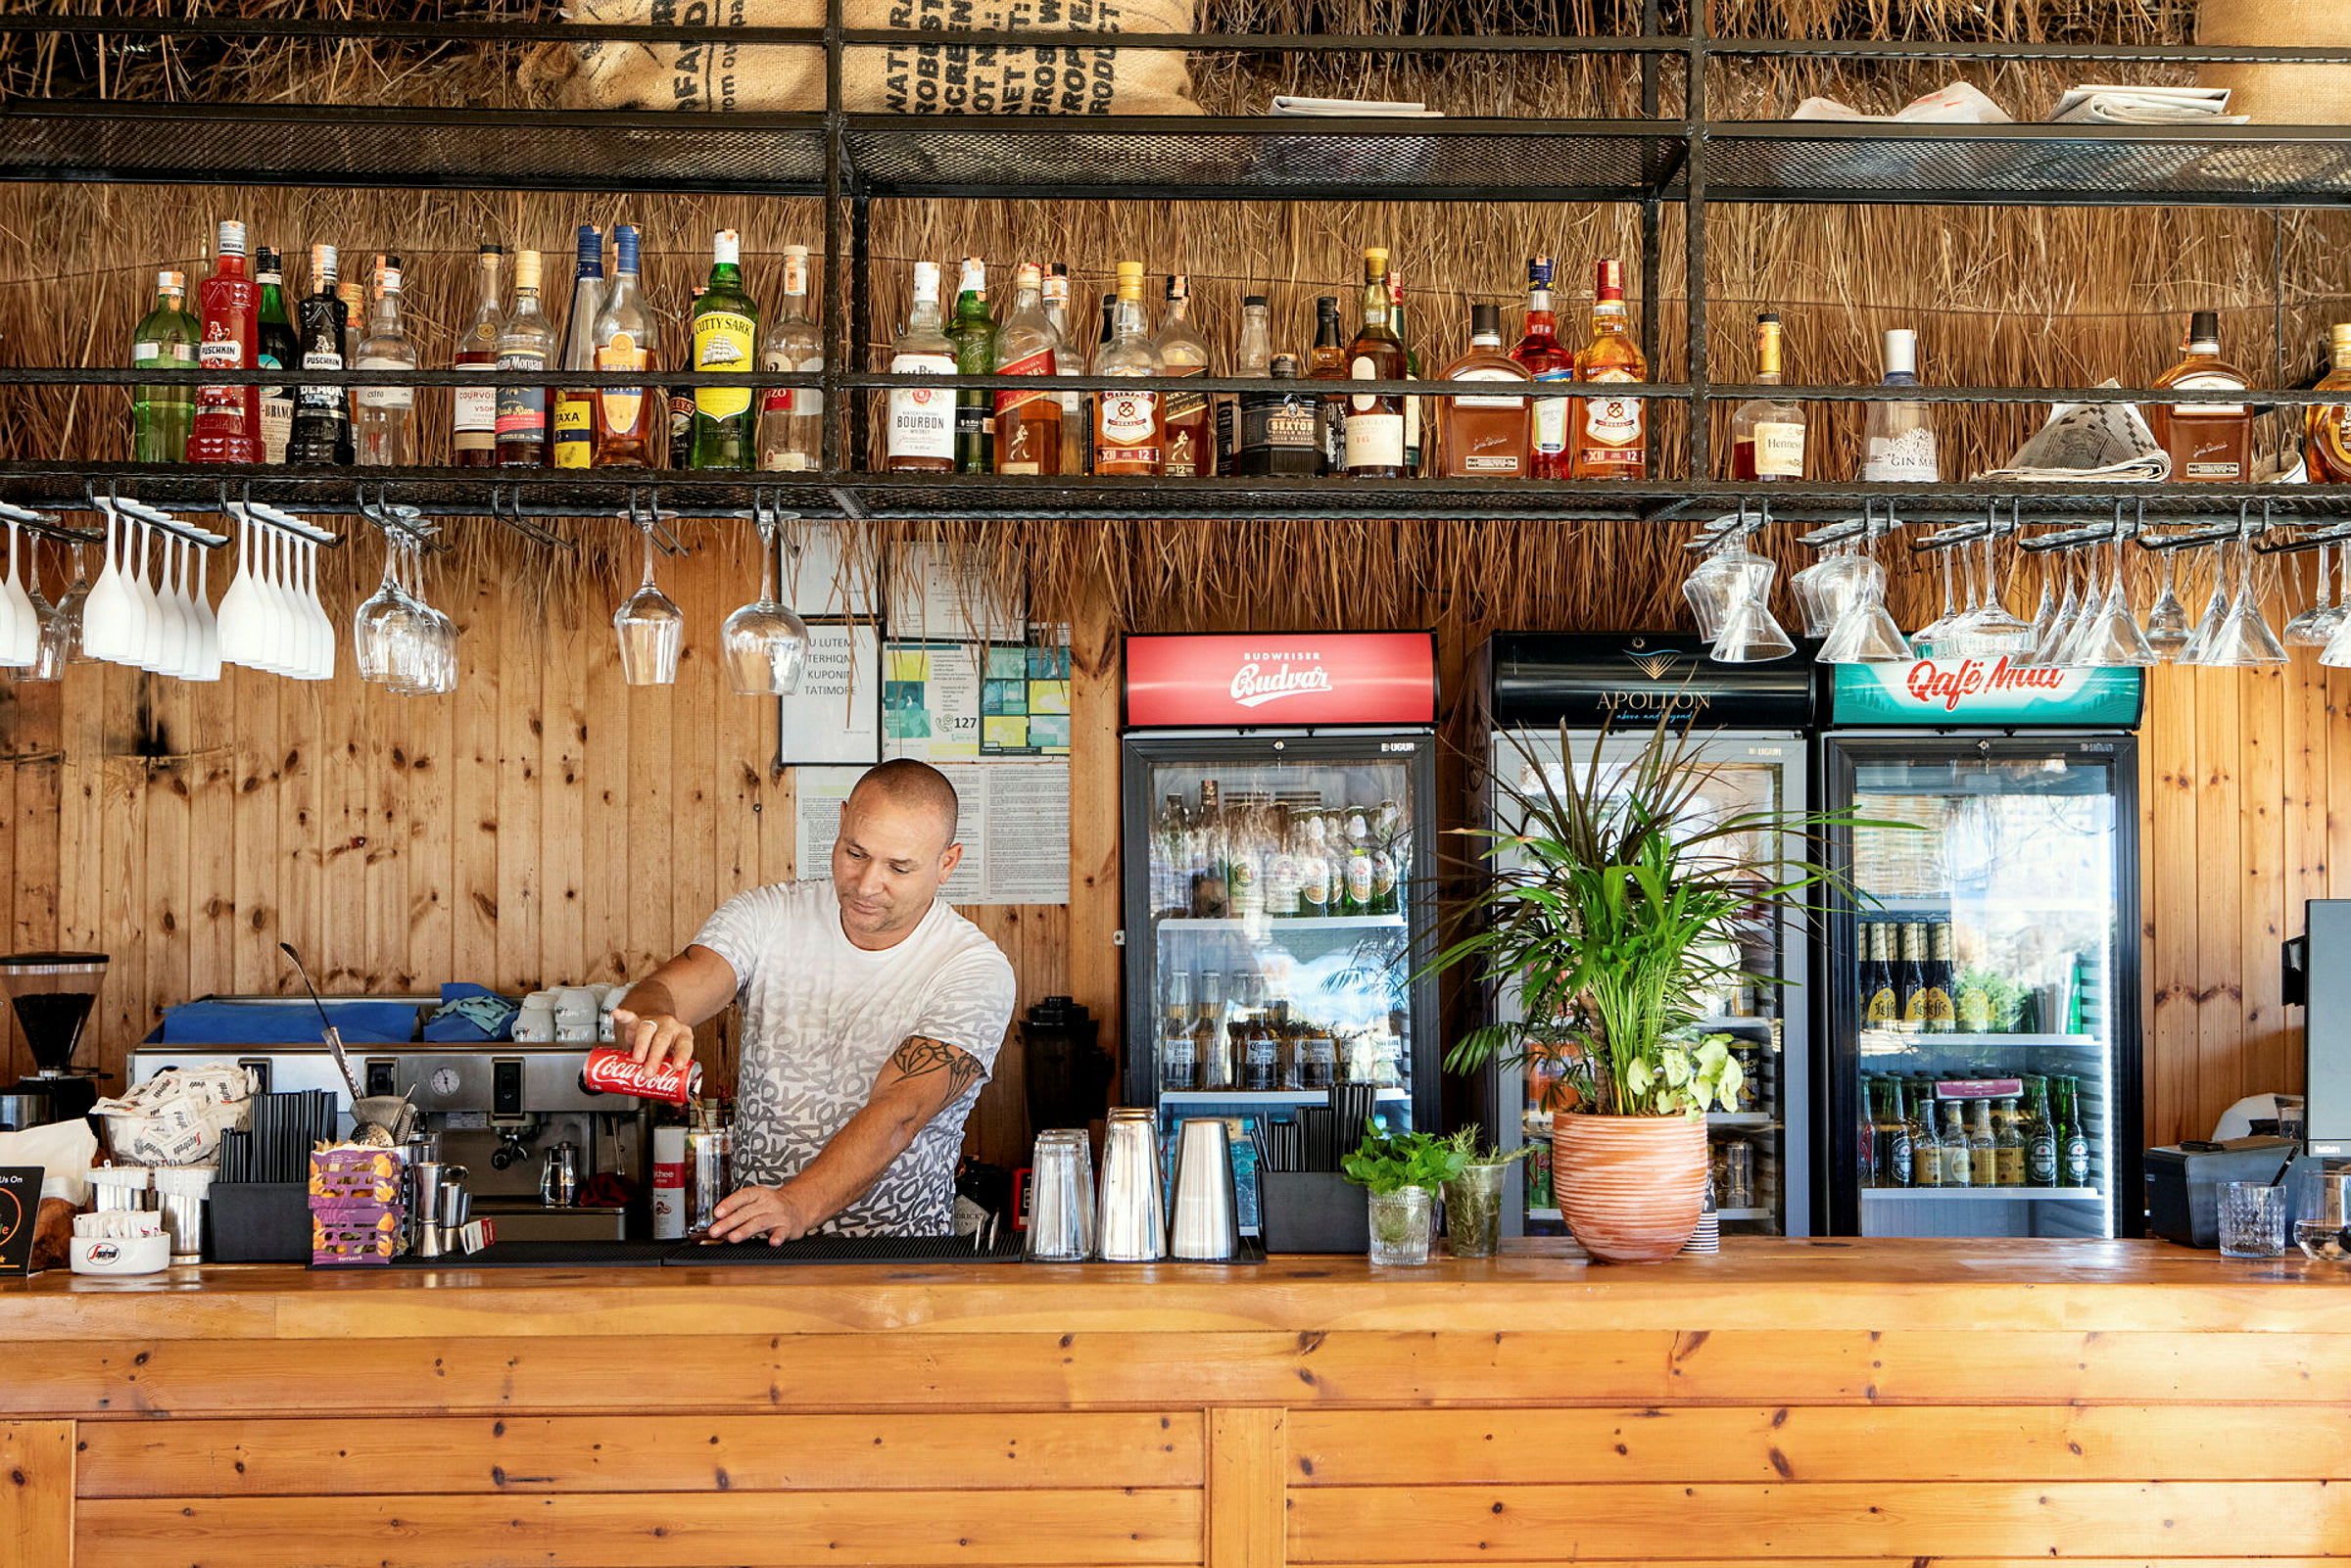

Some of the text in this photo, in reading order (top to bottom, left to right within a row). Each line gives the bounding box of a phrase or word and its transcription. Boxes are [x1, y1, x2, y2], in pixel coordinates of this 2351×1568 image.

[1059, 46, 1086, 116] ROP
[971, 75, 996, 115] OT
[695, 316, 752, 337] CUTTY SARK
[306, 356, 340, 366] PUSCHKIN
[897, 415, 944, 429] BOURBON
[1271, 420, 1315, 431] SEXTON
[1137, 450, 1150, 461] 12
[1626, 451, 1638, 461] 12
[1891, 457, 1915, 467] GIN
[1243, 651, 1321, 661] BUDWEISER
[1229, 662, 1334, 700] Budvar
[1906, 659, 1985, 711] Qafë
[1595, 690, 1711, 710] APOLLON
[1615, 710, 1640, 720] above
[1643, 710, 1662, 720] and
[953, 717, 978, 730] 127
[1927, 999, 1947, 1018] effe
[10, 1175, 24, 1184] On
